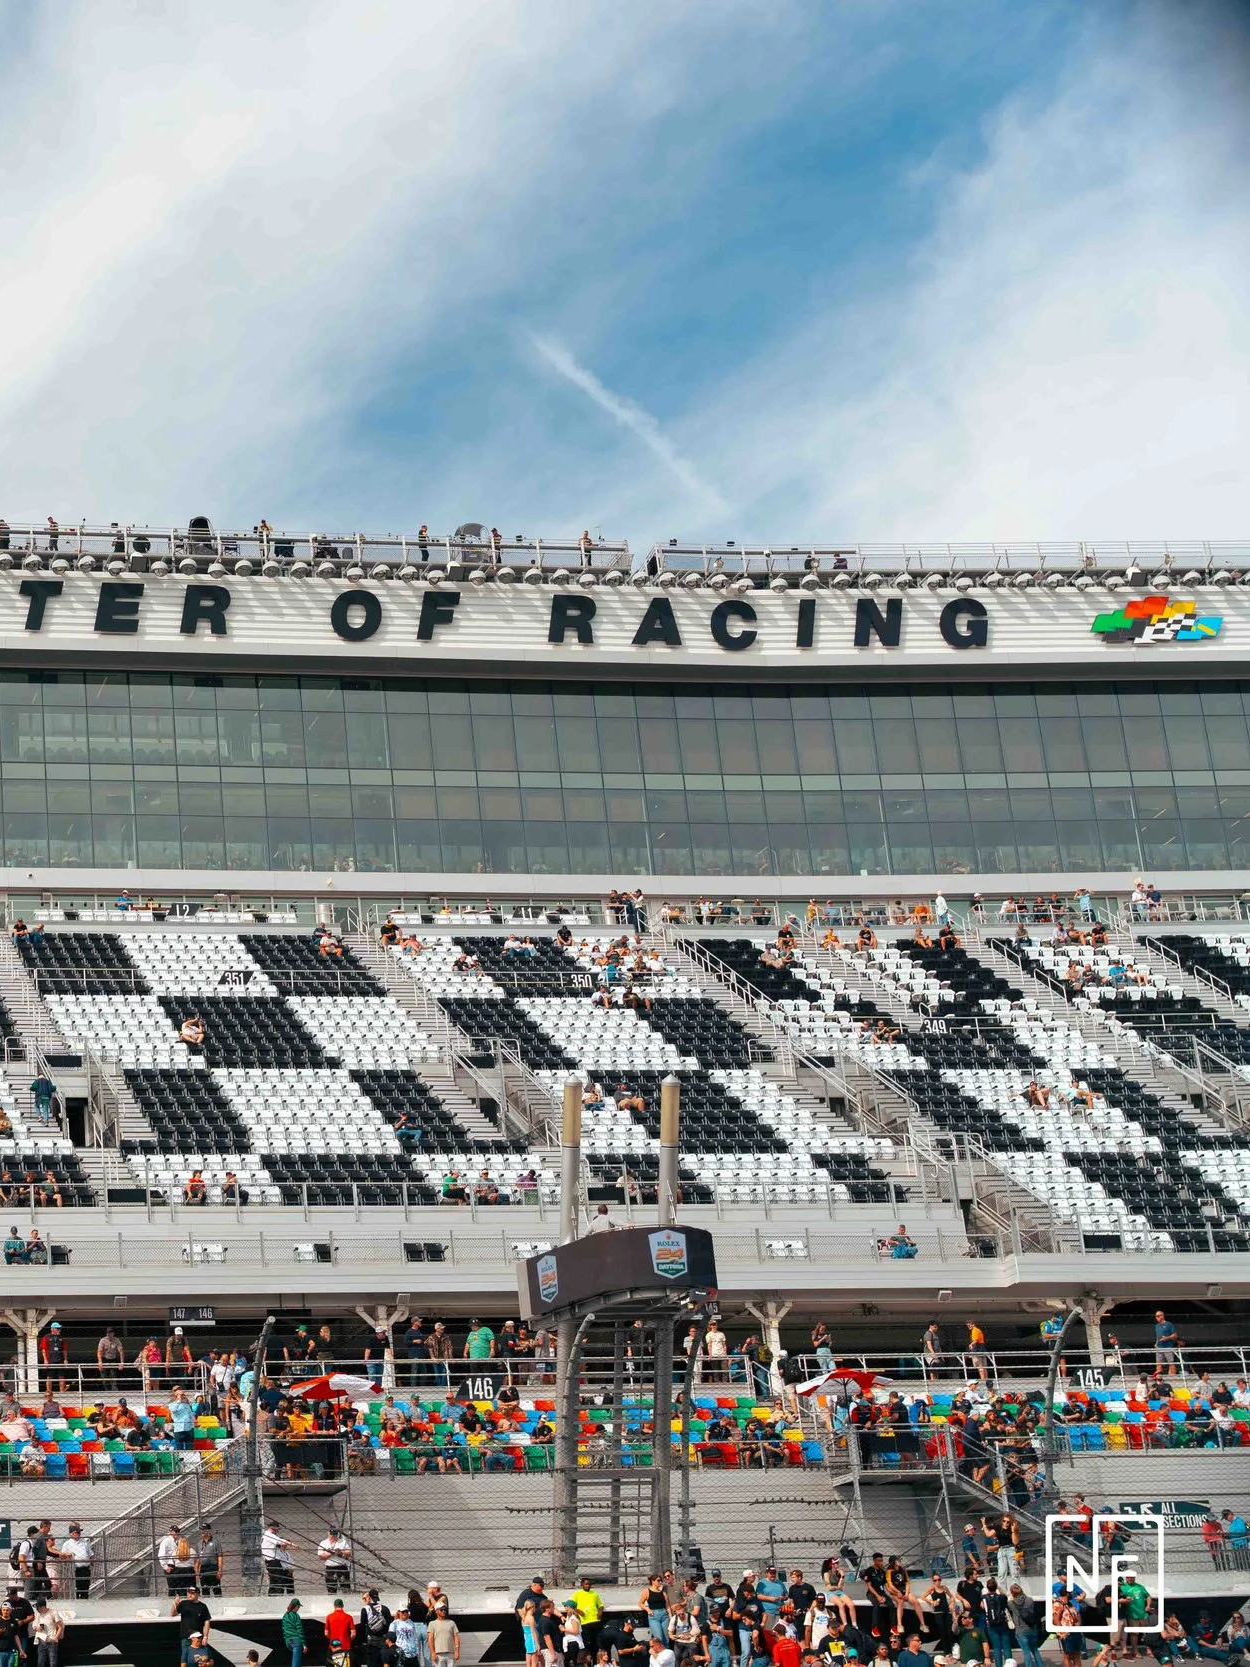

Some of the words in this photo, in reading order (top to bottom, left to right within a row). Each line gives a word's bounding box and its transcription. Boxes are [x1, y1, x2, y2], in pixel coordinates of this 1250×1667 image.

[330, 589, 462, 641] OF
[547, 594, 988, 650] RACING
[176, 904, 190, 919] L2
[521, 907, 533, 920] L1
[224, 972, 244, 986] 351
[571, 974, 592, 987] 350
[924, 1019, 946, 1034] 349
[655, 1247, 684, 1260] 24
[173, 1308, 186, 1319] 147
[199, 1308, 213, 1319] 146
[1077, 1368, 1105, 1390] 145
[466, 1377, 494, 1400] 146
[1161, 1502, 1177, 1514] ALL
